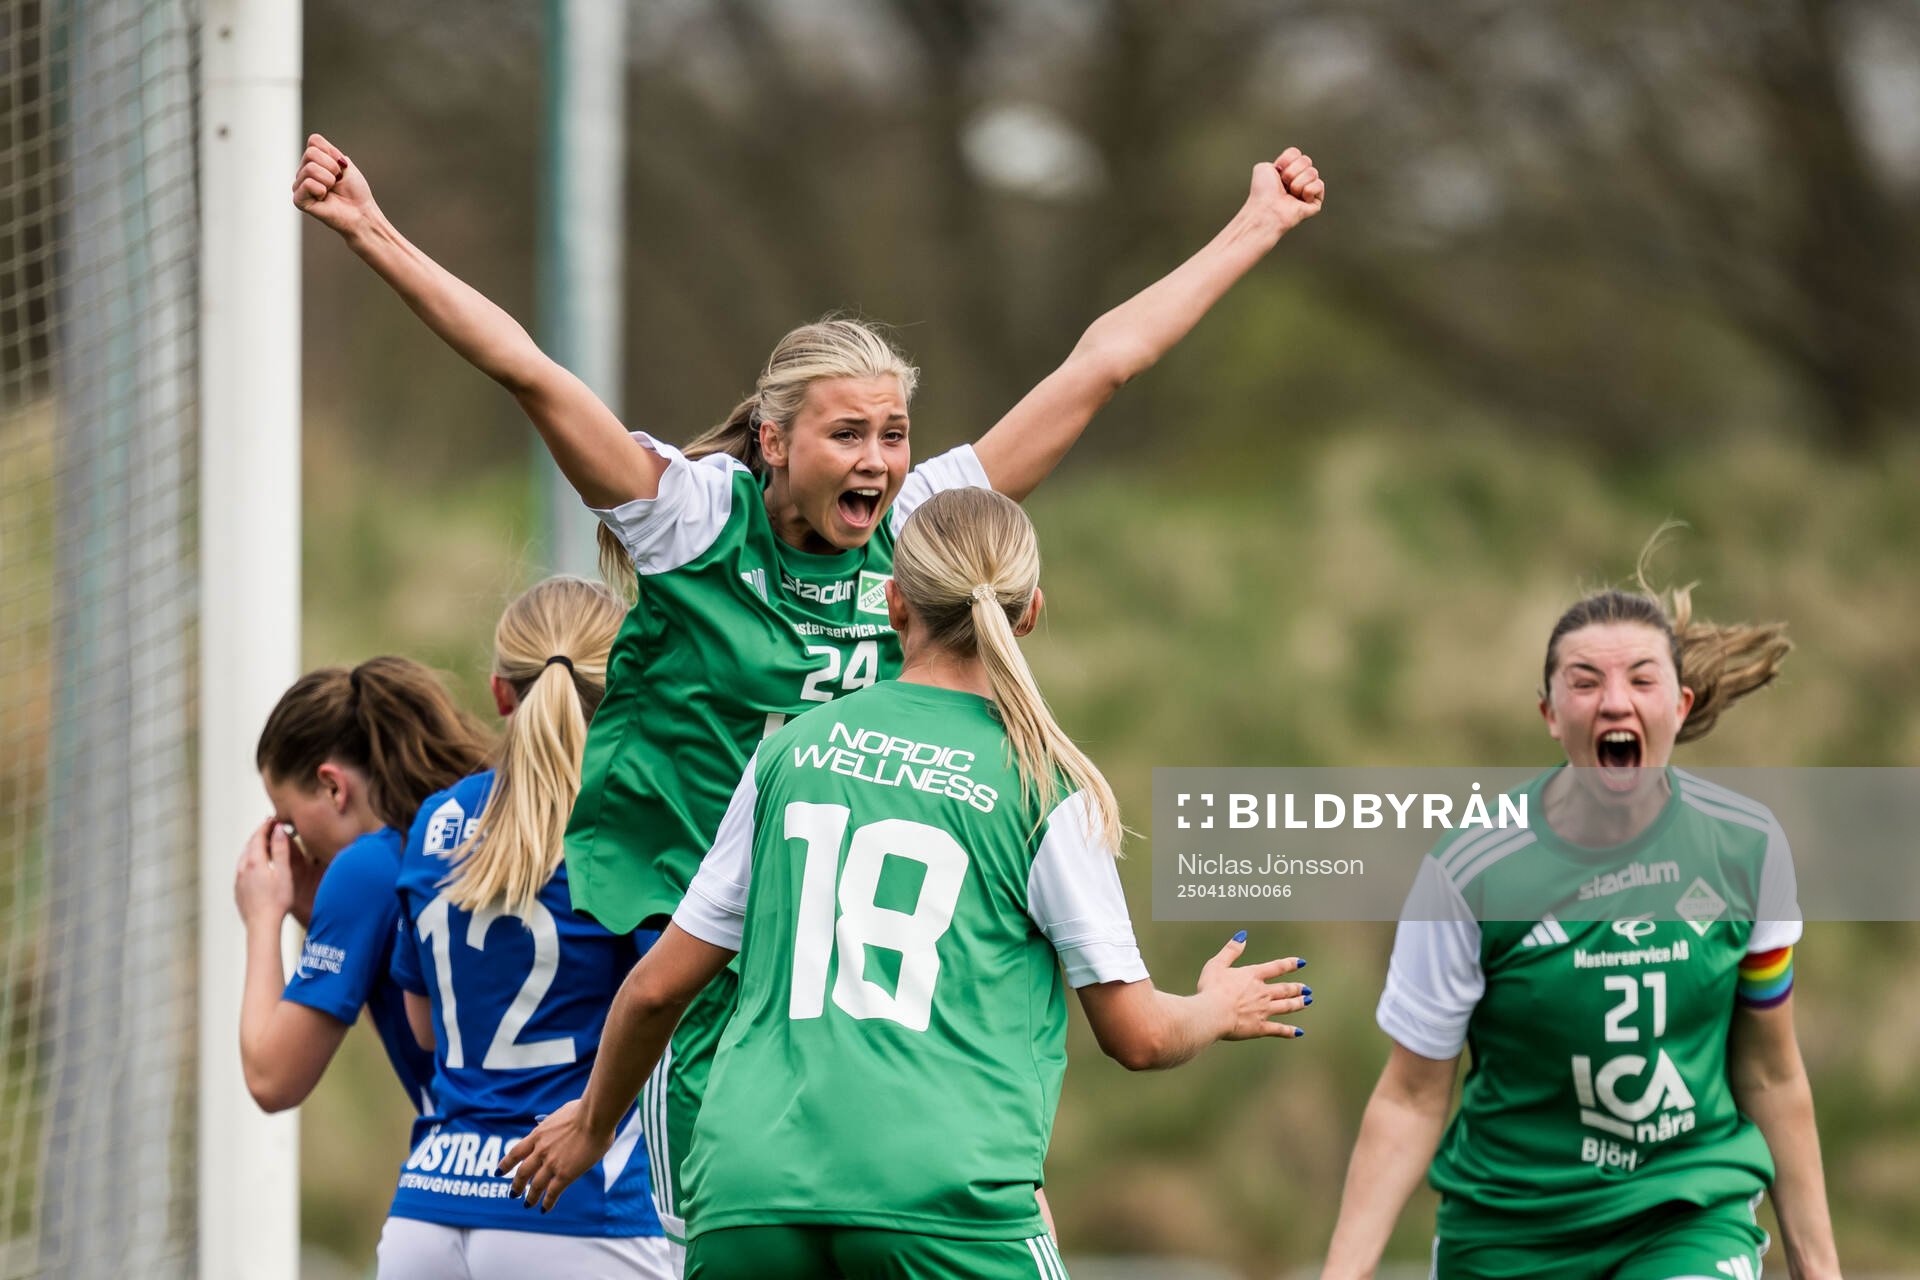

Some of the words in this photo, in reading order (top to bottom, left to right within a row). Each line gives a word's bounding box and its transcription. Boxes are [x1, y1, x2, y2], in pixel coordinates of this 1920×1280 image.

[862, 583, 887, 608] ZENI
[800, 640, 878, 702] 24
[828, 722, 976, 773] NORDIC
[794, 744, 999, 813] WELLNESS
[1578, 860, 1680, 900] stadium
[784, 801, 969, 1032] 18
[416, 893, 576, 1070] 12
[1574, 947, 1671, 968] Masterservice
[1604, 971, 1667, 1042] 21
[1571, 1047, 1696, 1122] ICA
[1581, 1136, 1637, 1172] Björl
[1636, 1110, 1696, 1143] nära
